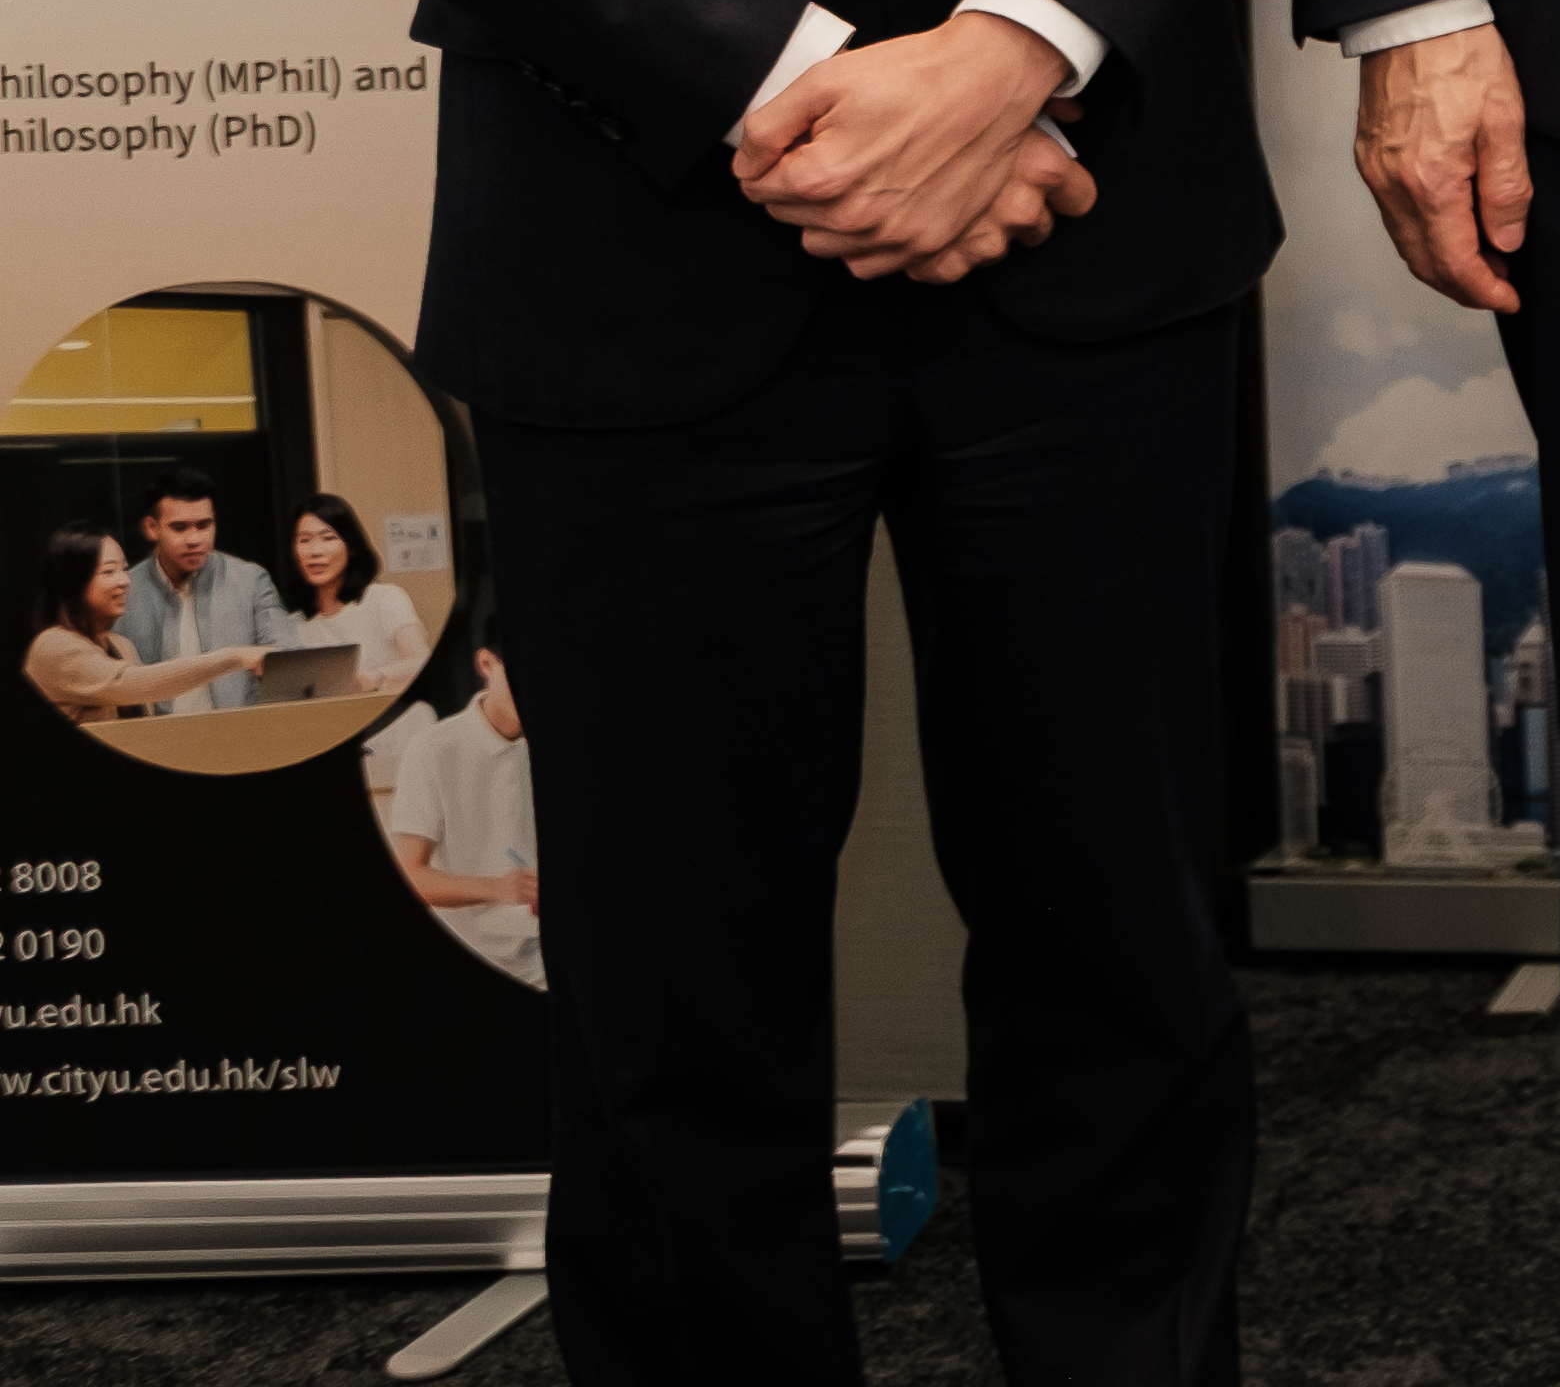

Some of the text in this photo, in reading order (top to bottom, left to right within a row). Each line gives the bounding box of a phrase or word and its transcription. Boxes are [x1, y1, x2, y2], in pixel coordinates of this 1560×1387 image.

[0, 55, 429, 106] hilosophy (MPhil) and
[0, 109, 317, 160] hilosophy (PhD)
[10, 859, 103, 894] 8008
[13, 927, 107, 962] 0190
[0, 992, 164, 1029] u.edu.hk
